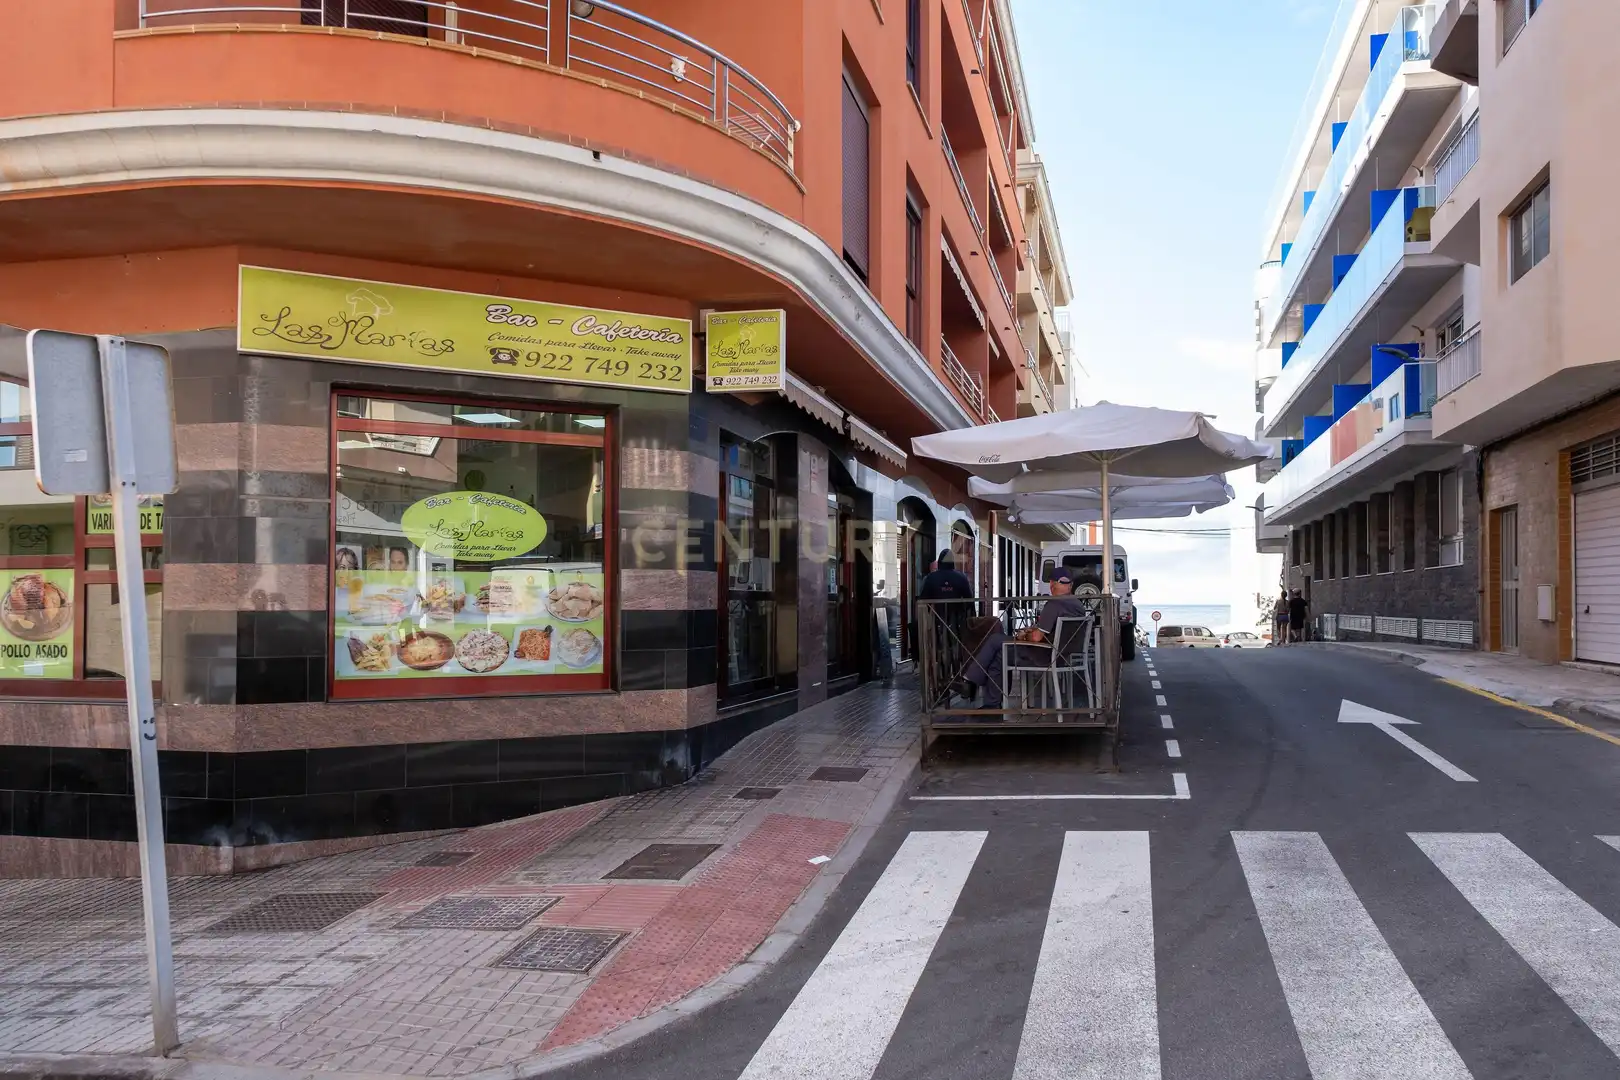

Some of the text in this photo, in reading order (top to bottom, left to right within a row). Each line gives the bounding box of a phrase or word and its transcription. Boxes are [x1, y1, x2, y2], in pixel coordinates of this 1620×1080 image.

[252, 306, 455, 356] Las Marías
[485, 304, 538, 328] Bar
[571, 315, 684, 345] Cafetería
[711, 315, 728, 325] Bar
[488, 332, 542, 344] Comidas
[544, 338, 576, 350] para
[578, 341, 617, 353] Llevar
[624, 346, 650, 358] Take
[651, 351, 681, 361] away
[711, 338, 778, 359] Las Marías
[524, 351, 683, 382] 922 749 232
[725, 375, 778, 386] 922 749 232
[424, 496, 451, 509] Bar
[468, 493, 527, 515] Cafetería
[92, 513, 114, 530] VARI
[140, 513, 152, 530] DE
[425, 518, 524, 541] Las Marías
[1, 644, 68, 658] POLLO ASADO
